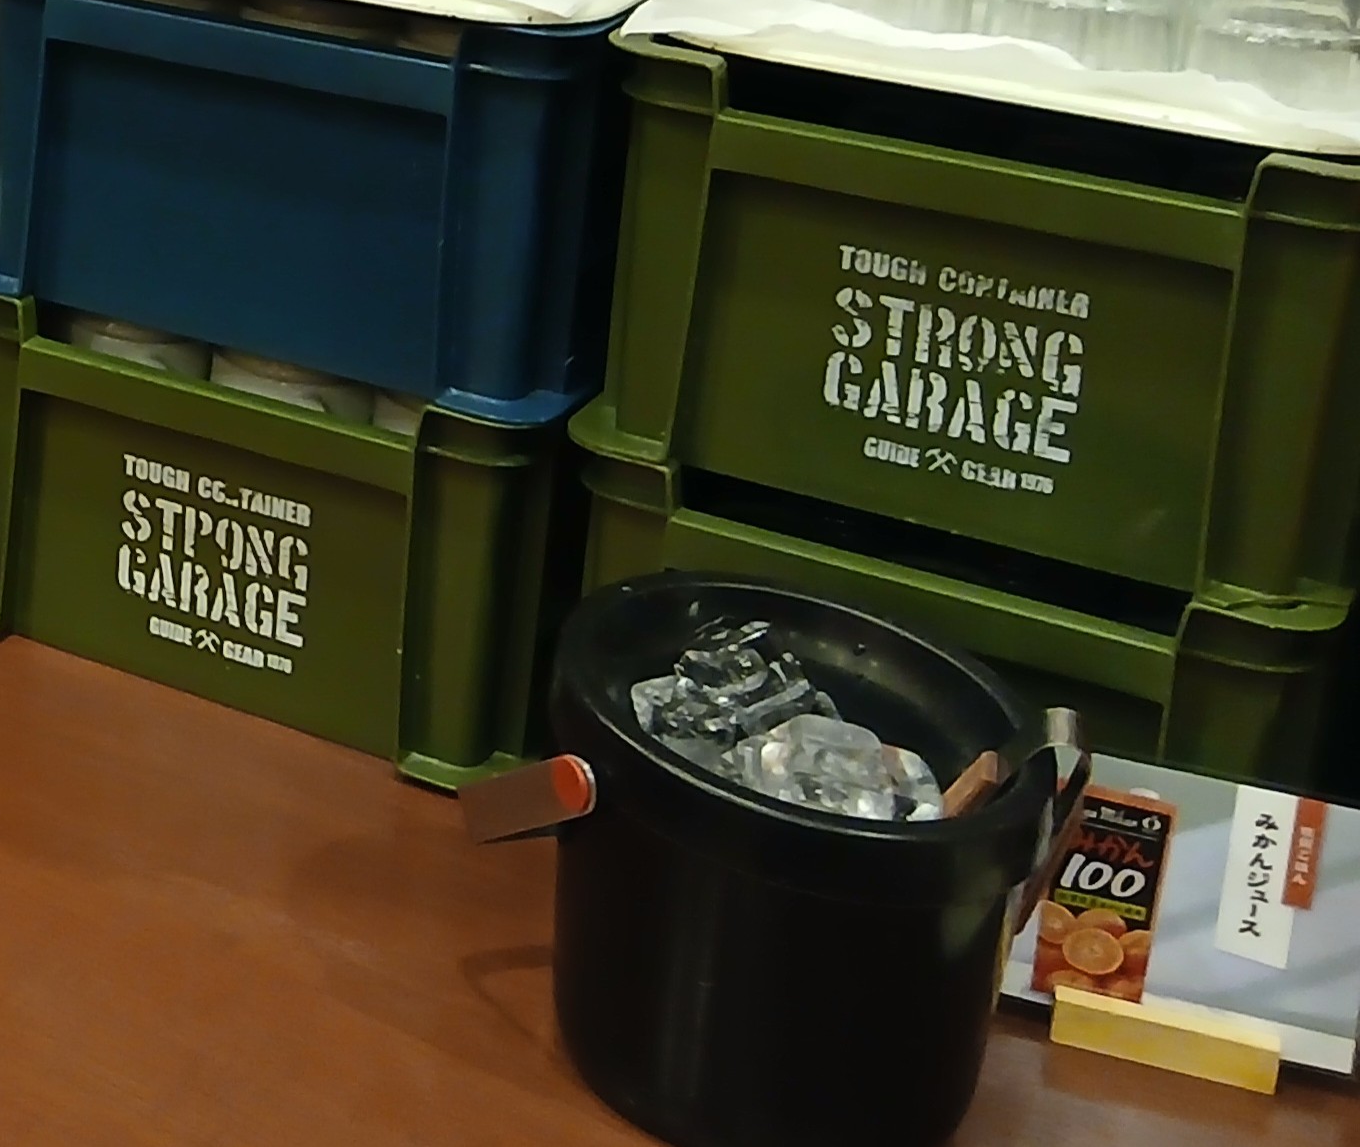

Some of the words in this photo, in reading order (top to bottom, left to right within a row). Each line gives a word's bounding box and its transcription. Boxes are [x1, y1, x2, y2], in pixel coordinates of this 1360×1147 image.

[839, 244, 927, 286] TOUGH
[831, 286, 1084, 398] STRONG
[823, 350, 1078, 464] GARAGE
[121, 489, 309, 592] STRONG
[122, 453, 191, 493] TOUGH
[197, 475, 312, 527] COTAINER
[117, 543, 307, 649] GARAGE
[1060, 852, 1146, 898] 100
[1238, 813, 1279, 937] みかんジュース
